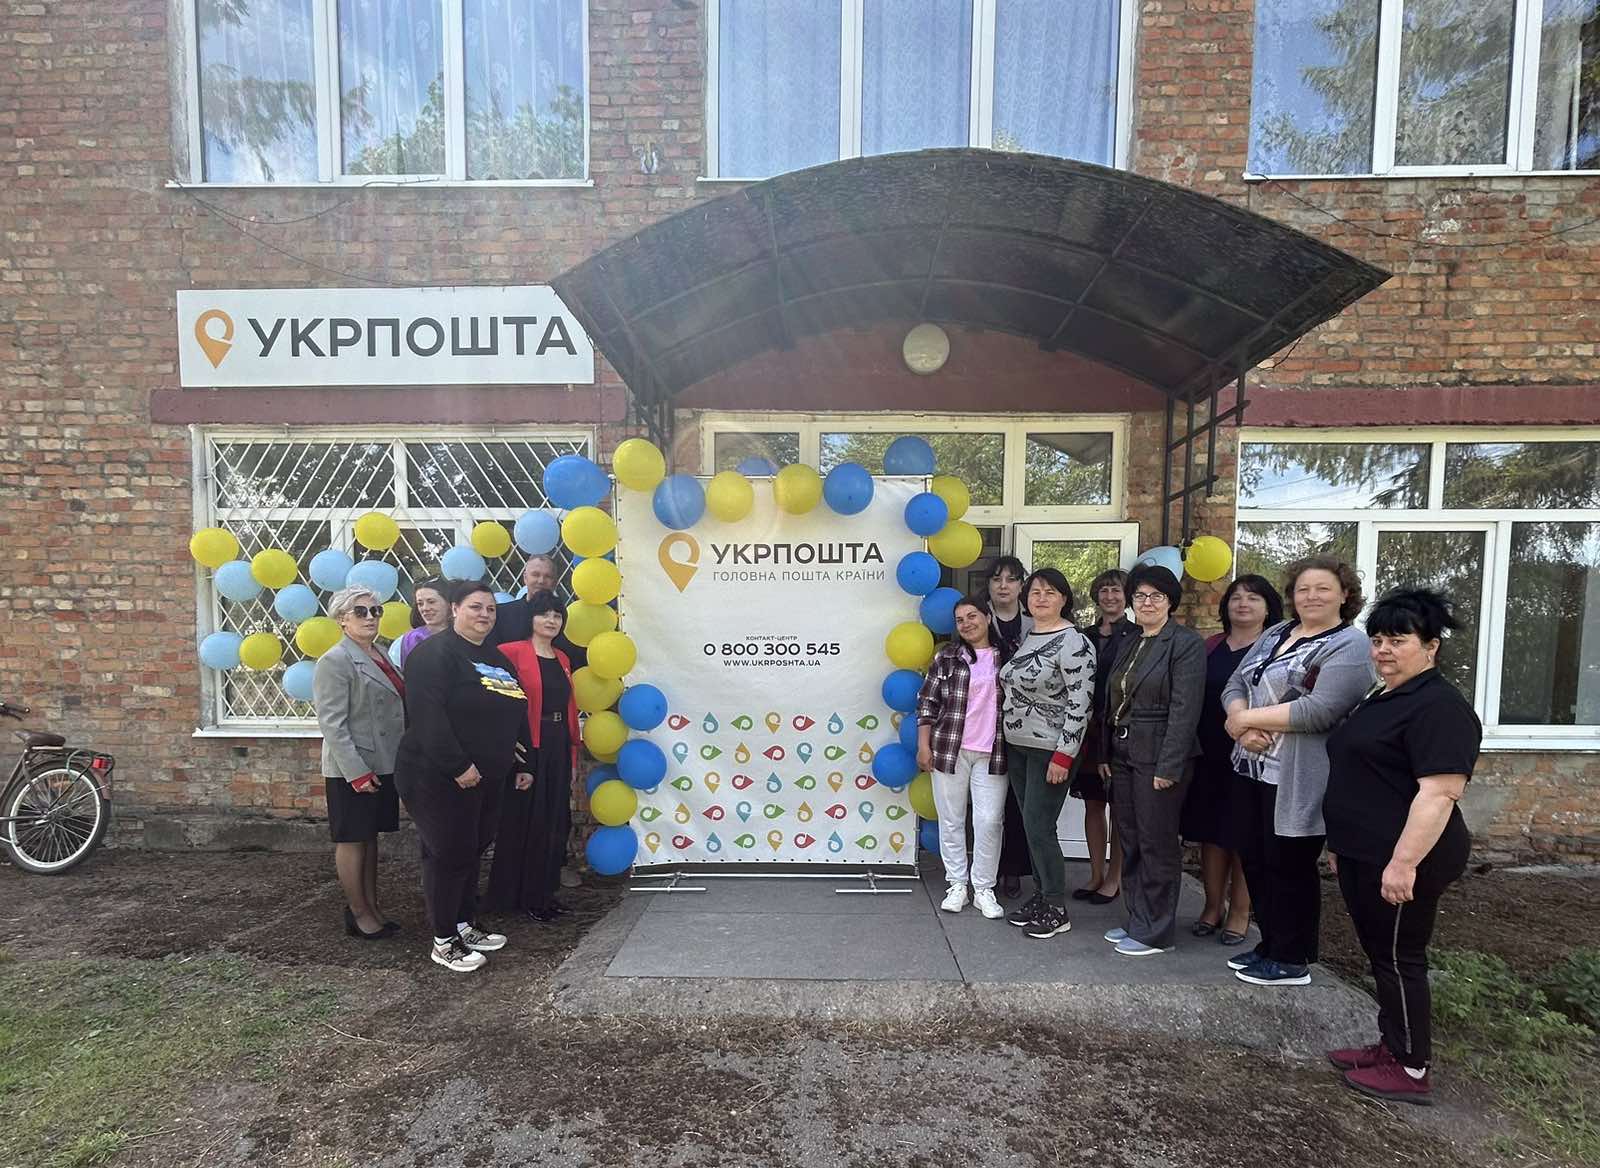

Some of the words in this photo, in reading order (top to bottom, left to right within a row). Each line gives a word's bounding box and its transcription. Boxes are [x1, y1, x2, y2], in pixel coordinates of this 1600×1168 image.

[247, 316, 578, 358] УКРПОШТА
[710, 543, 884, 565] УКРПОШТА
[713, 570, 777, 582] ГОЛОВНА
[782, 570, 831, 582] ПОШТА
[836, 570, 885, 582] КРАЇНИ
[703, 643, 716, 656] 0
[721, 643, 759, 656] 800
[763, 643, 800, 656] 300
[805, 643, 841, 656] 545
[723, 659, 821, 667] WWW.UKRPOSHTA.UA
